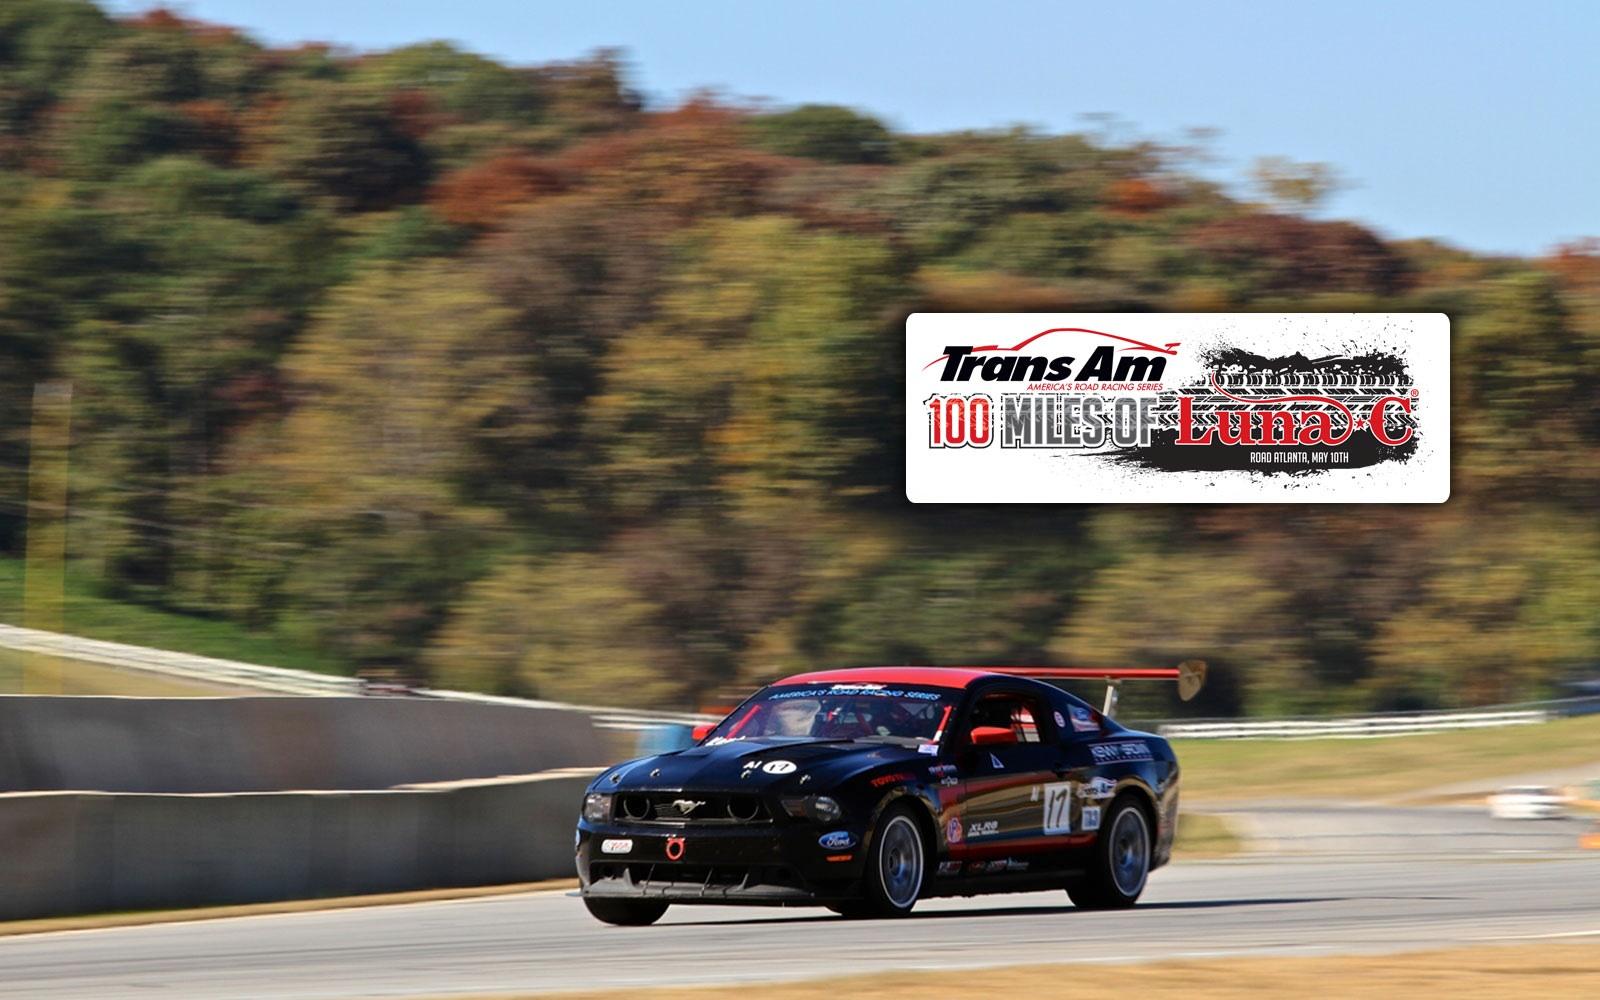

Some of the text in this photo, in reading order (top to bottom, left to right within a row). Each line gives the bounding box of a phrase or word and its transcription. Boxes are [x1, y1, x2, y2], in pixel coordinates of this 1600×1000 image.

[827, 688, 860, 696] ROAD
[859, 689, 904, 697] RACING
[1046, 787, 1069, 830] 17
